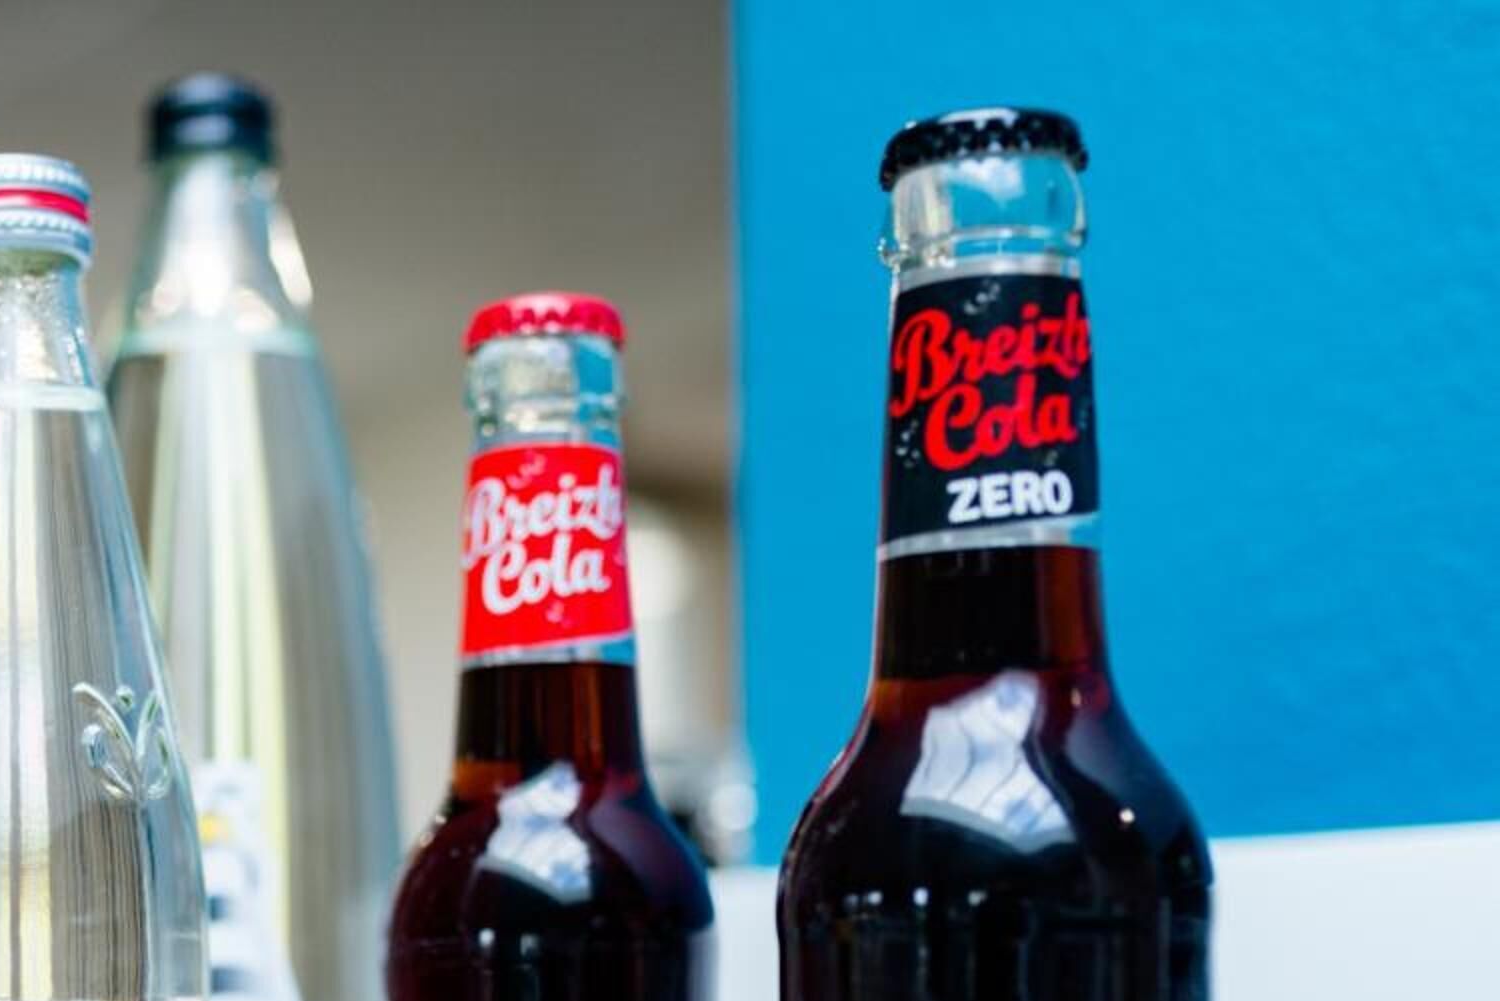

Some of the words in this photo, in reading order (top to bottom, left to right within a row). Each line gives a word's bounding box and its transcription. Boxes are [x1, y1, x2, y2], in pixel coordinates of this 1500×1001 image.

[889, 291, 1089, 418] Breizh
[924, 372, 1078, 471] Cola
[461, 463, 622, 571] Breizh
[946, 470, 1073, 523] ZERO
[482, 532, 612, 616] Cola
